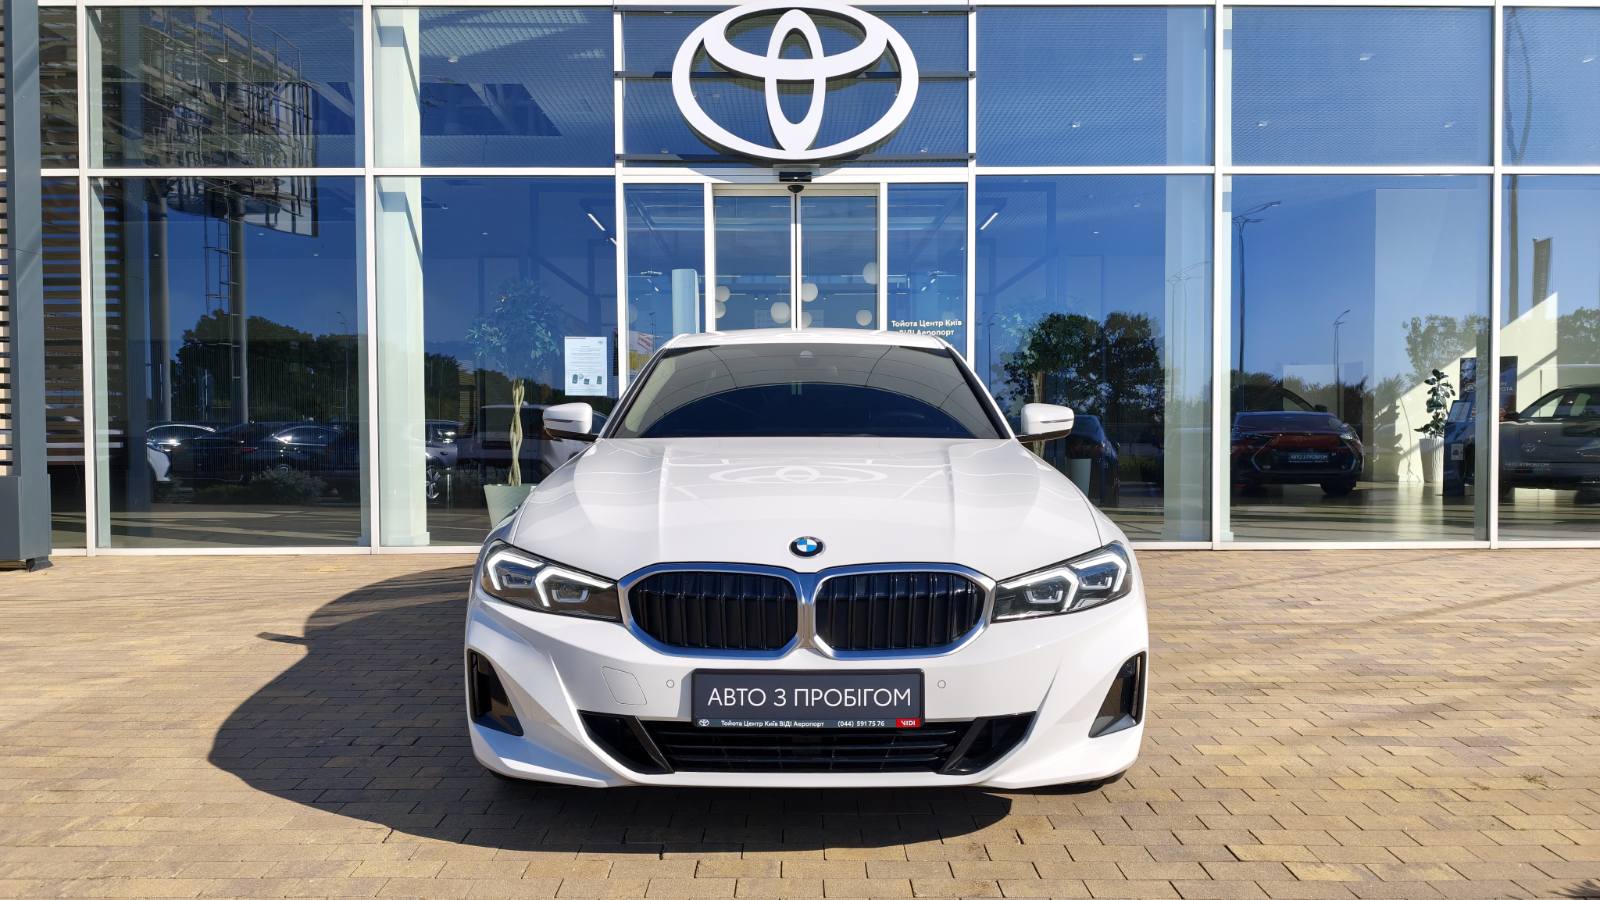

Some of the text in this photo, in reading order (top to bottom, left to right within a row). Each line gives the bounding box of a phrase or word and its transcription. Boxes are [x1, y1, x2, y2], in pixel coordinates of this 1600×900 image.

[919, 320, 944, 328] Центр
[707, 688, 911, 707] АВТО З ПРОБІГОМ
[743, 720, 763, 728] Центр
[779, 720, 792, 728] ВІДІ
[837, 720, 854, 728] (044)
